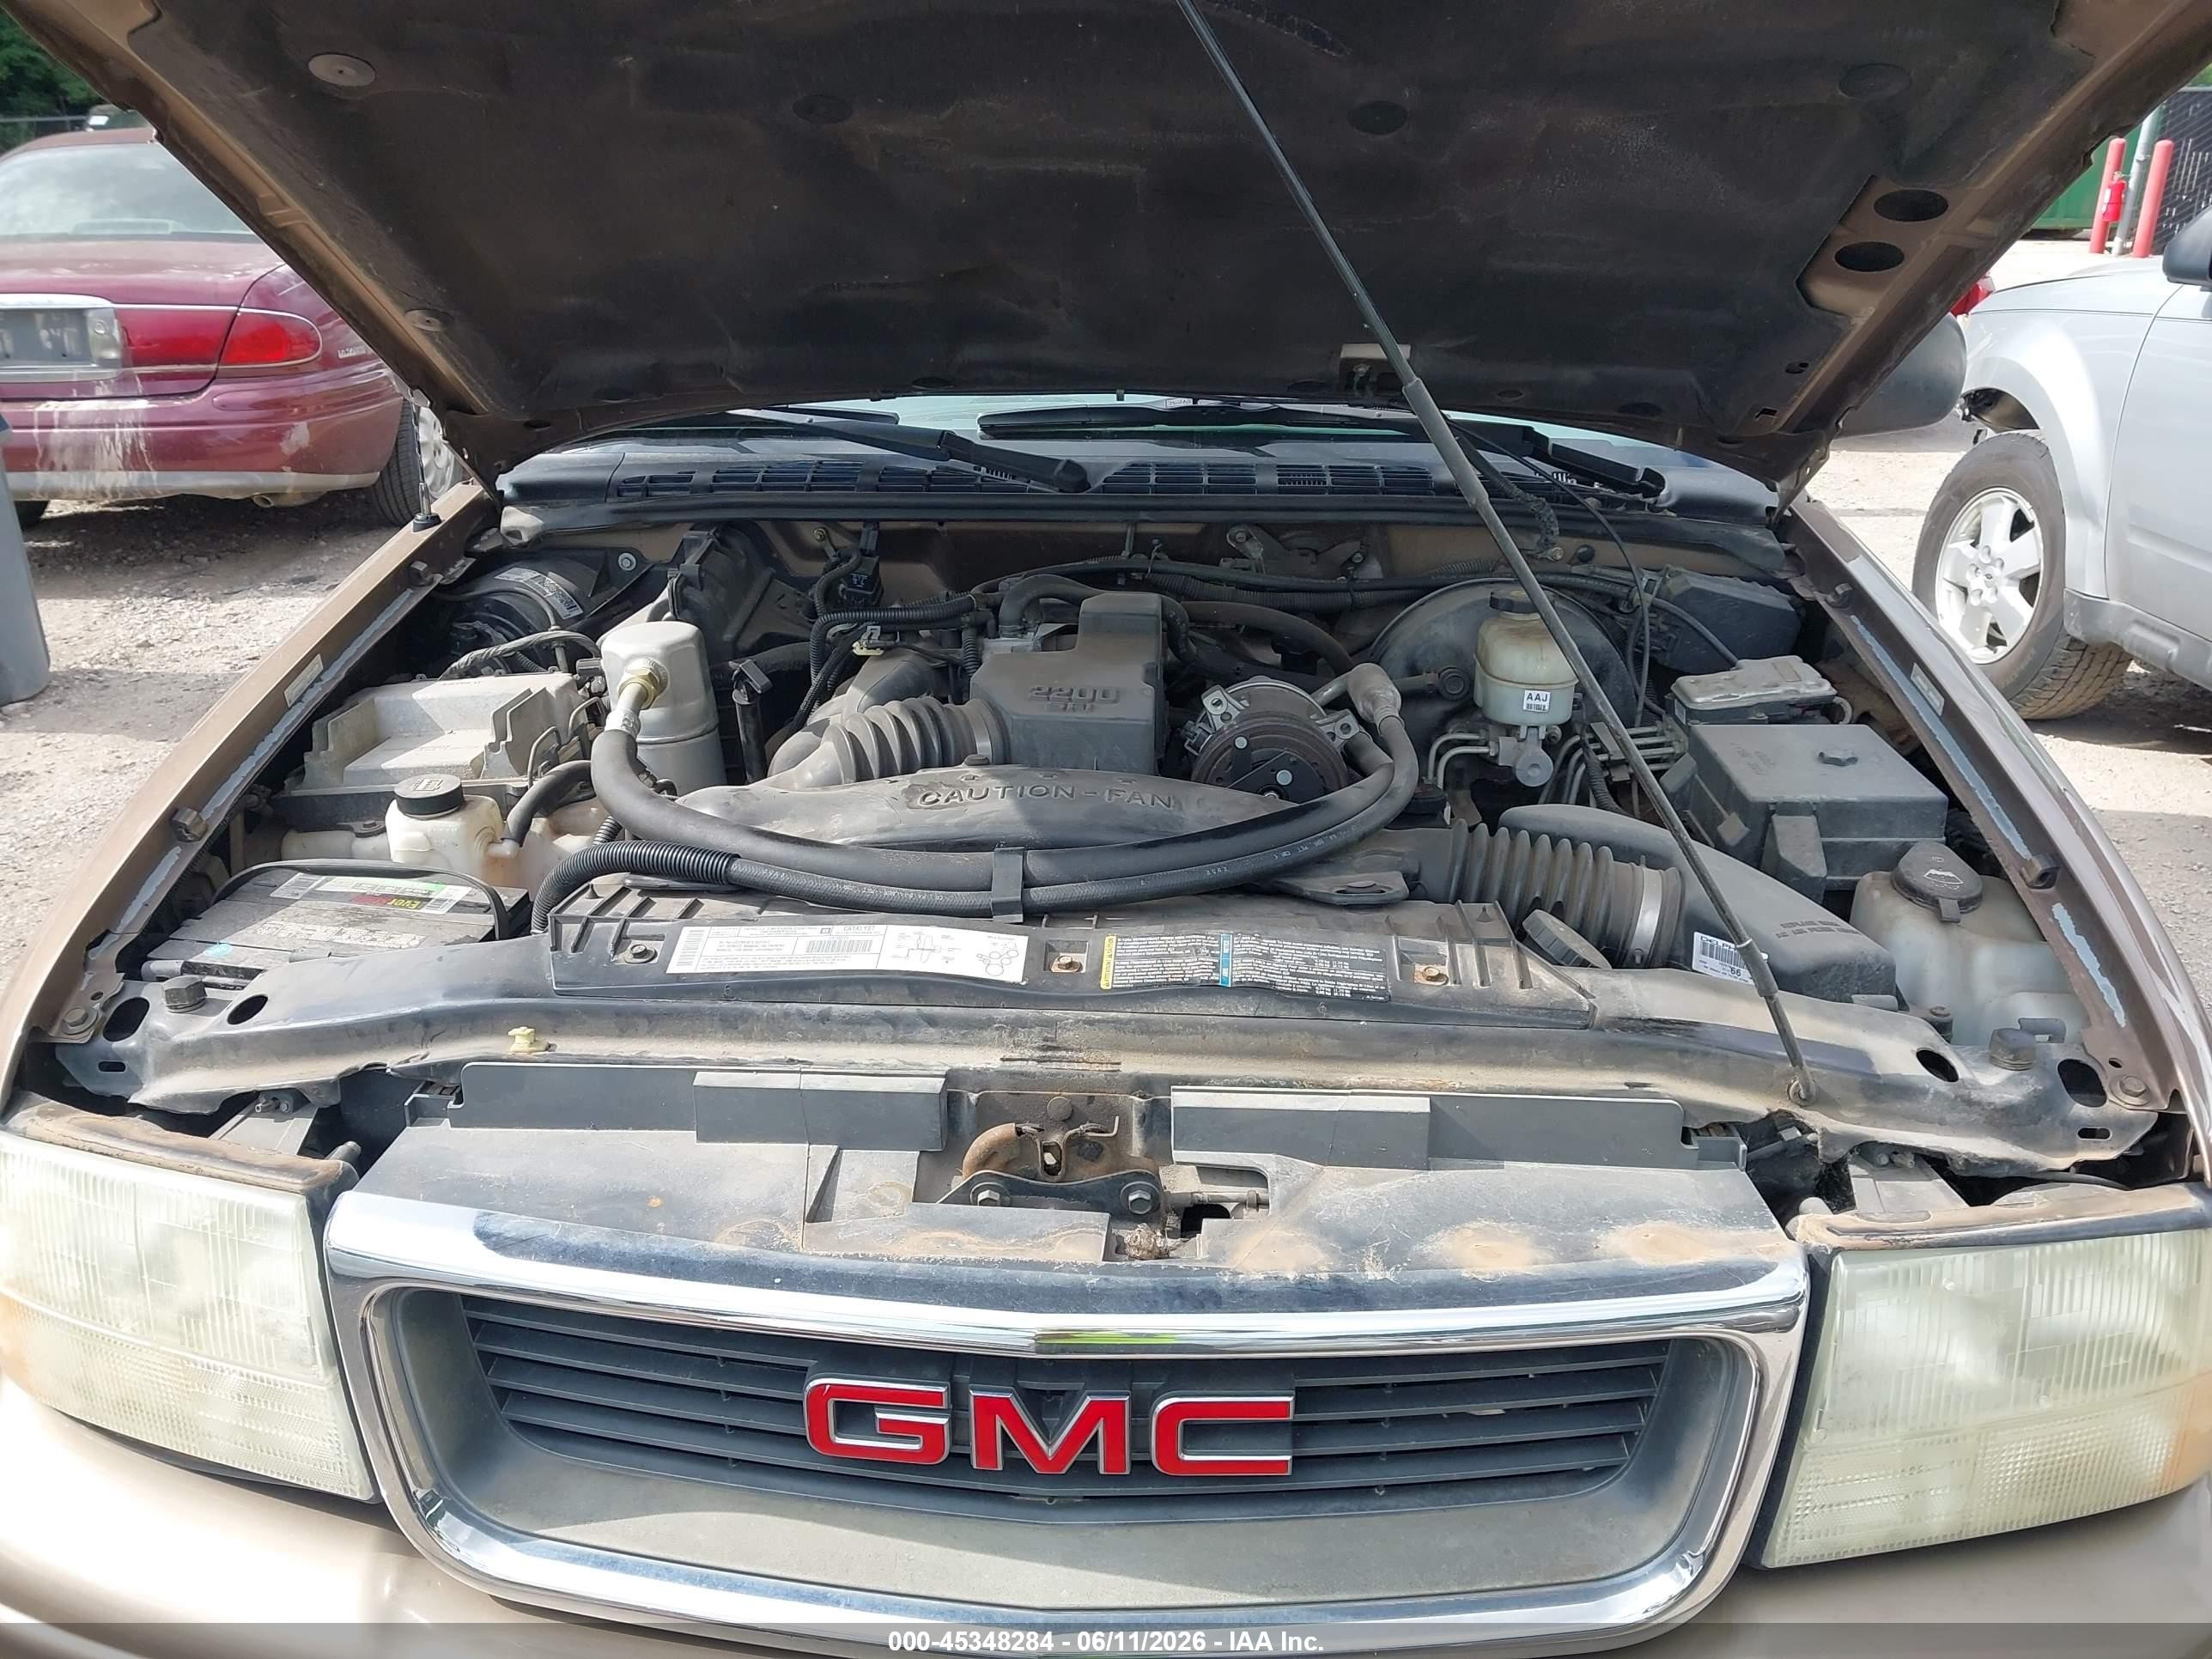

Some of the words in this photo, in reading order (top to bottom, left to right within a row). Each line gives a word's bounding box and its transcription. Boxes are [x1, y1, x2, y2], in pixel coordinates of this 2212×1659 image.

[1029, 686, 1119, 702] 2200
[1526, 692, 1547, 702] AAJ
[919, 785, 1075, 806] CAUTION
[1106, 789, 1174, 811] FAN
[1730, 967, 1741, 976] 66
[804, 1378, 1294, 1474] GMC
